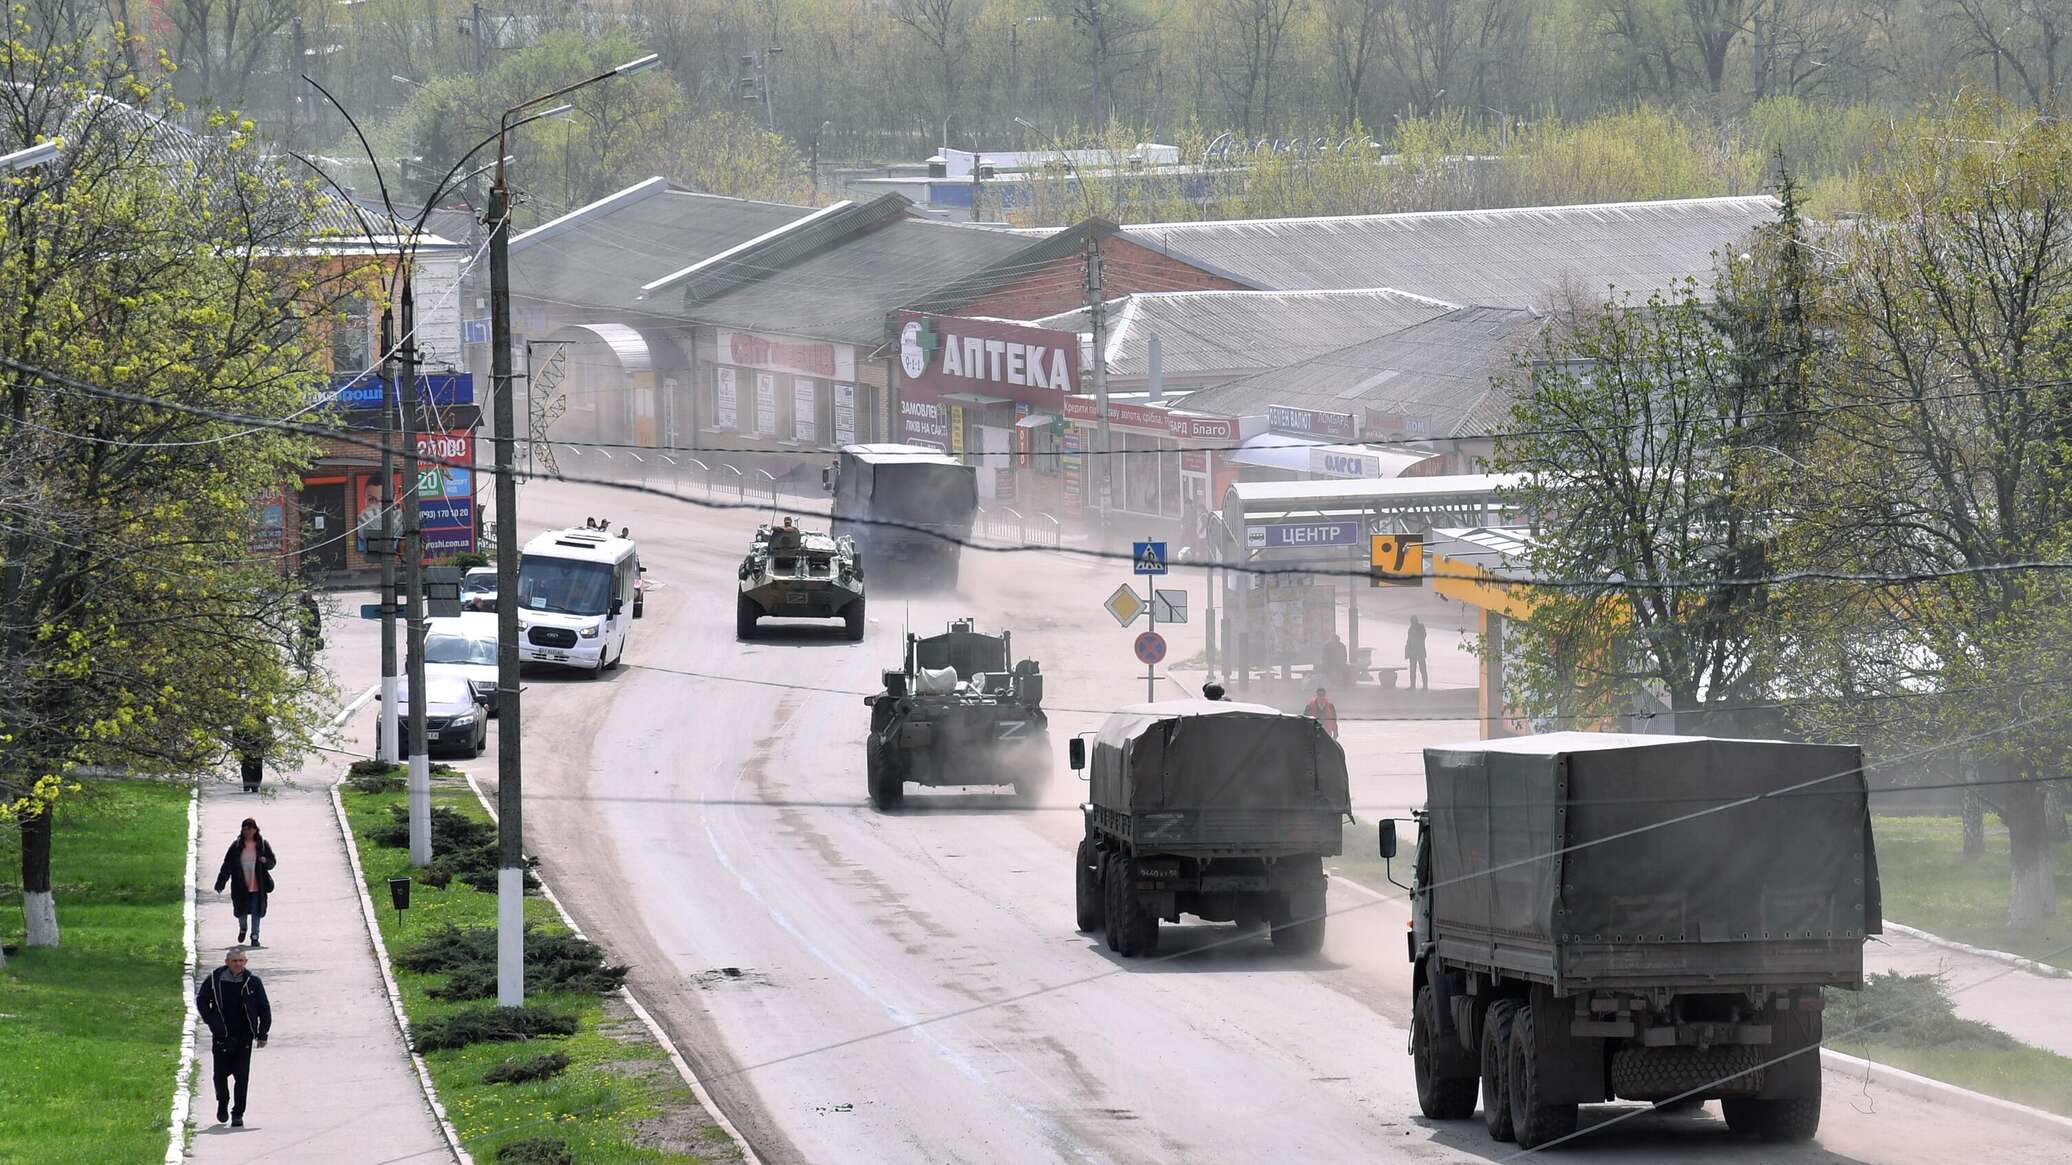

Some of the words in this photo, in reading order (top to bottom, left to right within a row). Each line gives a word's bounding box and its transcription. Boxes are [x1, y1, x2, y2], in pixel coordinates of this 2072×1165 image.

[942, 334, 1072, 392] АПТЕКА
[1192, 423, 1226, 436] Благо
[418, 470, 438, 490] 20
[437, 510, 449, 518] 170
[459, 508, 469, 517] 20
[1282, 526, 1341, 545] ЦЕНТР
[999, 720, 1026, 740] Z
